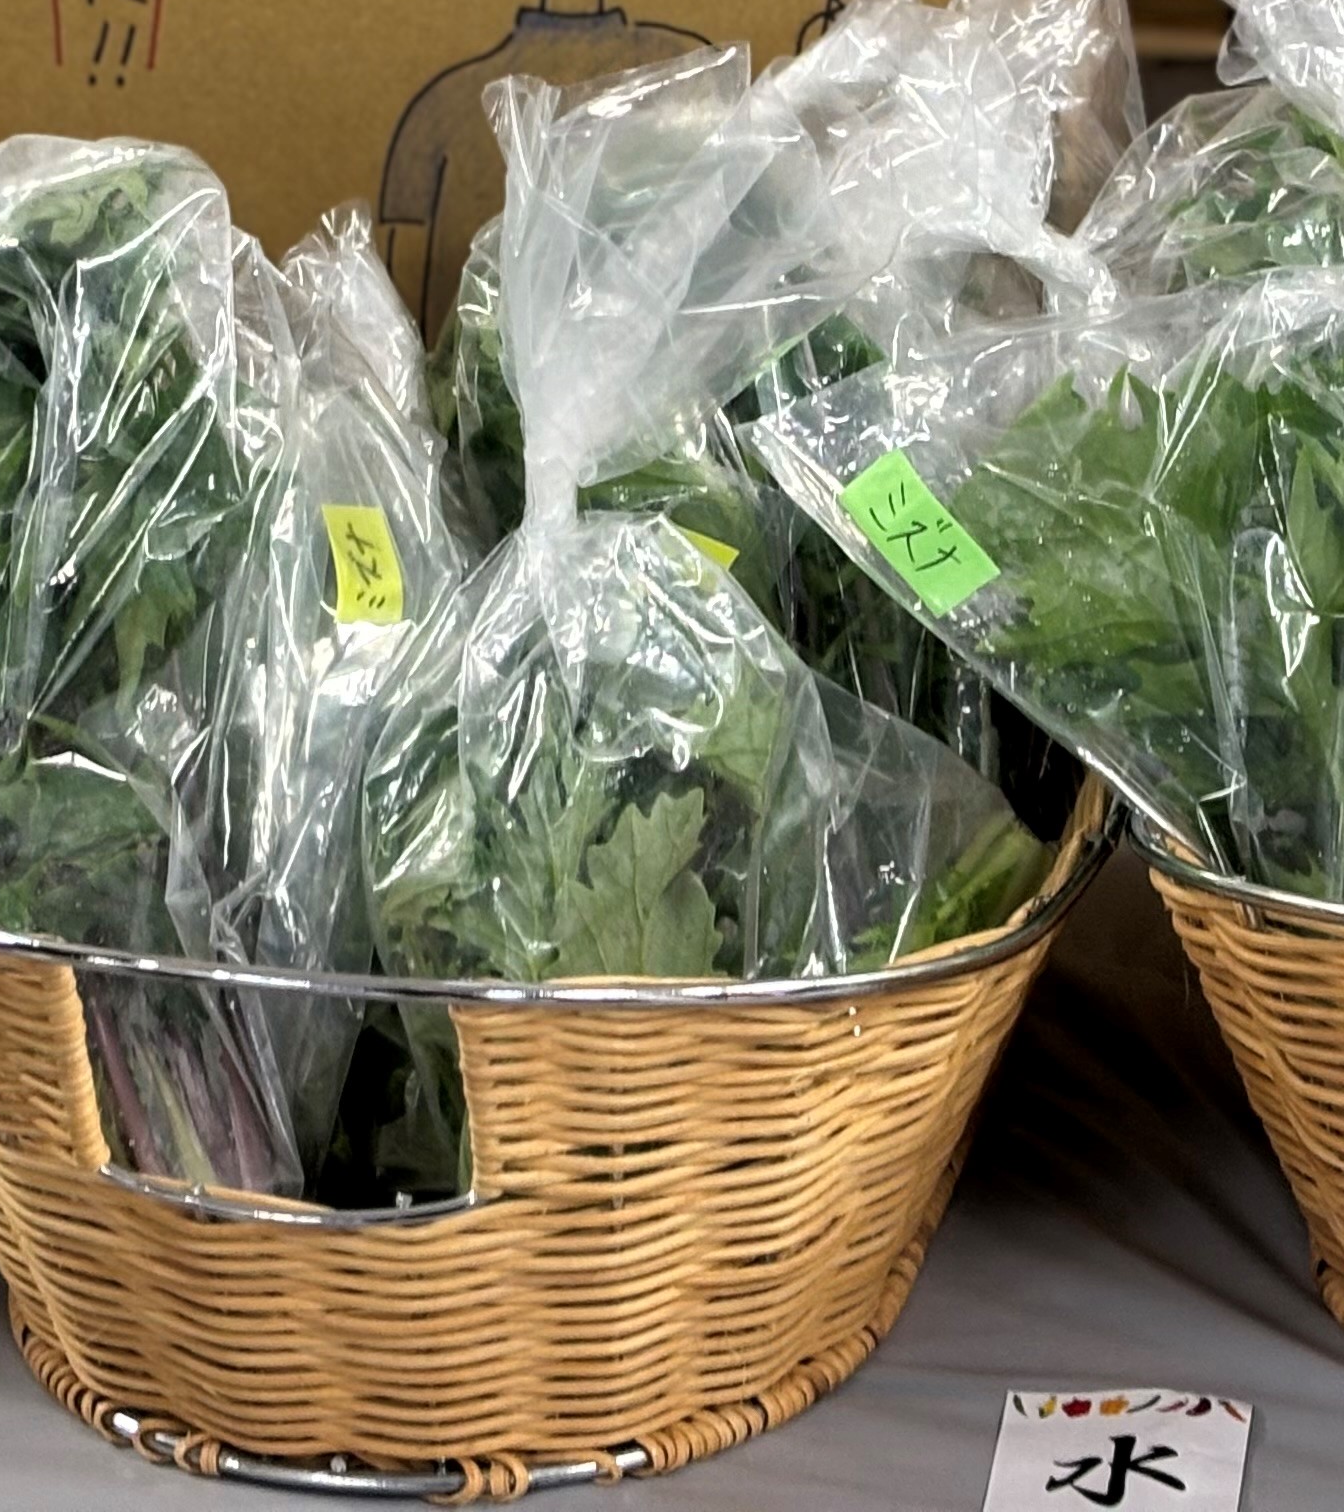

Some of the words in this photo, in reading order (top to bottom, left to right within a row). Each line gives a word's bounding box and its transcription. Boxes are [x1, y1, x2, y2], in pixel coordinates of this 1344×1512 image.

[868, 479, 962, 572] ミズナ
[1045, 1435, 1187, 1507] 水
